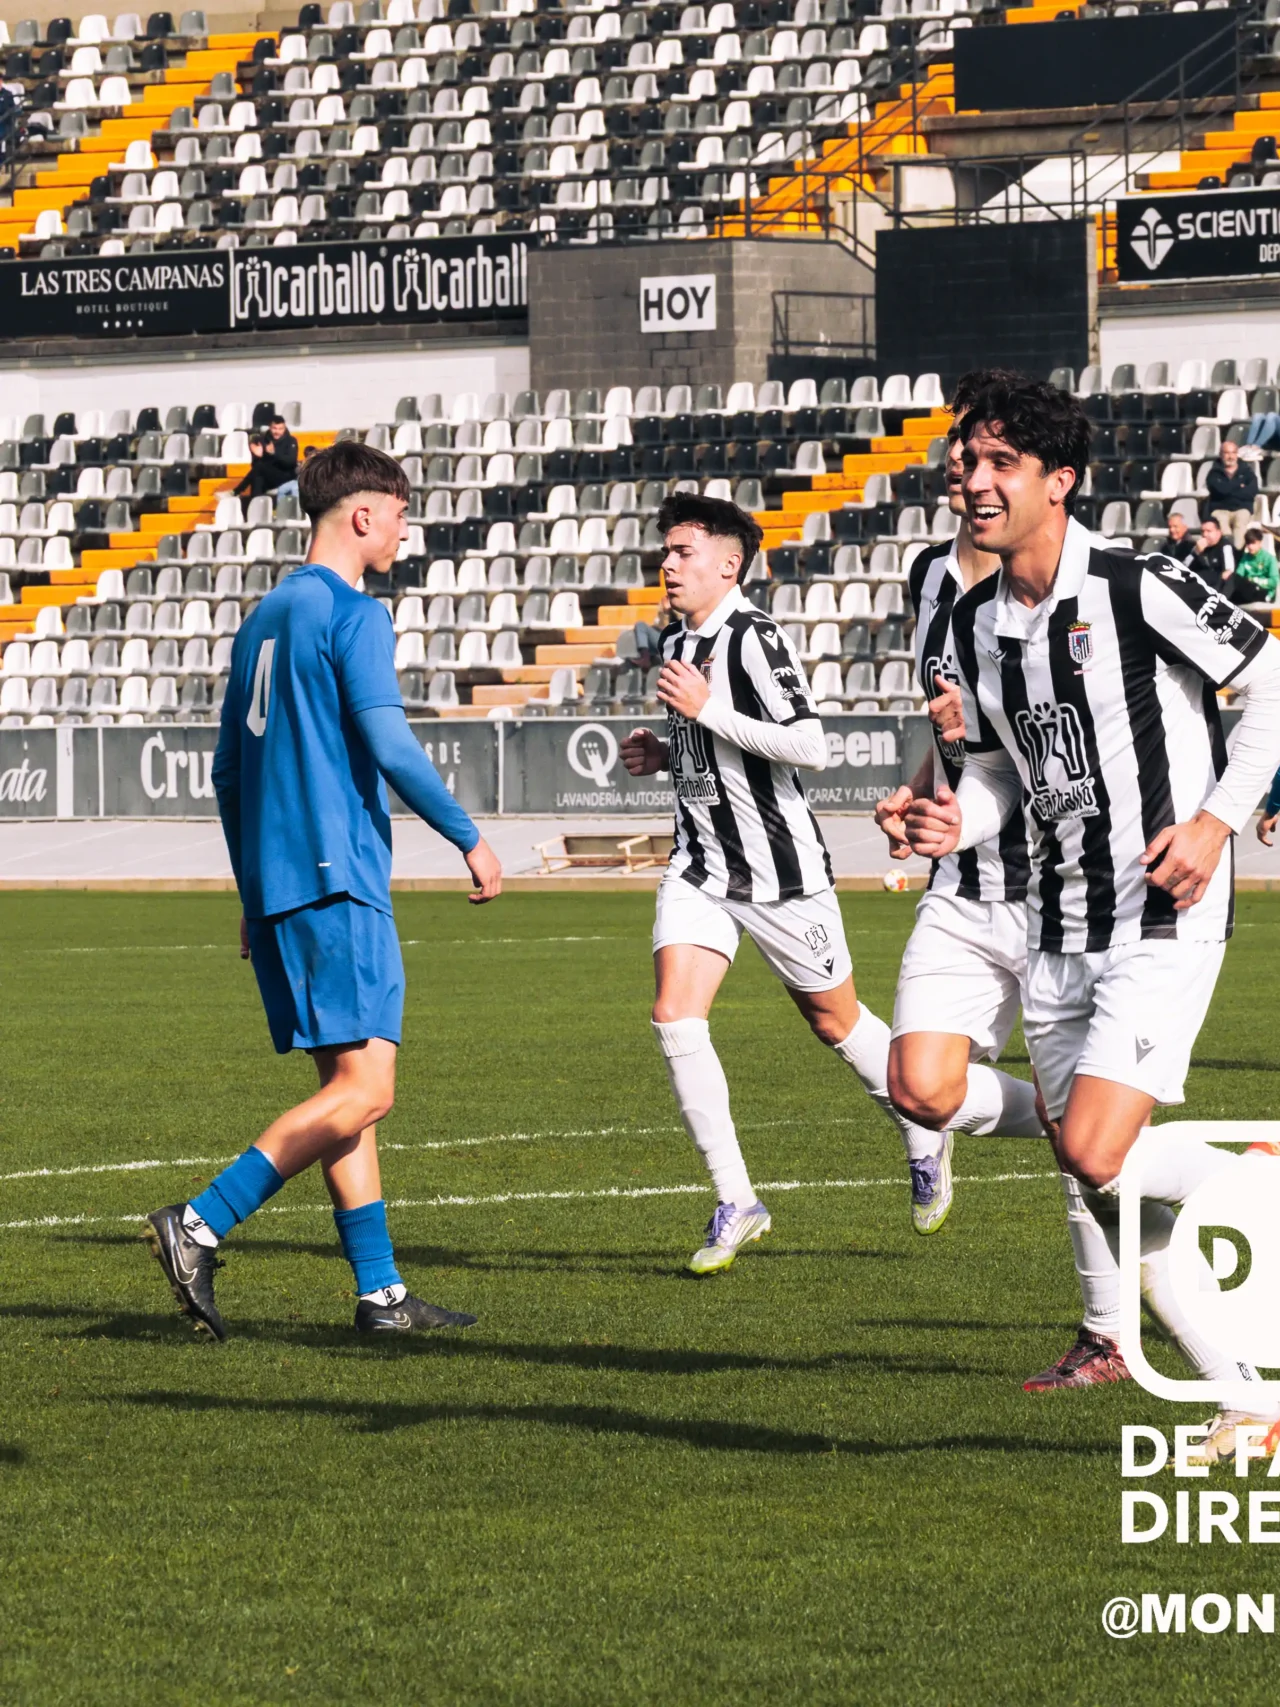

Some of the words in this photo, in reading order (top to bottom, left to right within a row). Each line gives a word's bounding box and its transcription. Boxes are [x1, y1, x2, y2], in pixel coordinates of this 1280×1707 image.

[21, 270, 60, 296] LAS
[62, 268, 112, 294] TRES
[115, 263, 224, 292] CAMPANAS
[273, 251, 385, 318] carballo
[76, 304, 110, 314] HOTEL
[115, 301, 169, 313] BOUTIQUE
[644, 285, 711, 321] HOY
[556, 789, 622, 807] LAVANDERÍA
[623, 791, 676, 806] AUTOSER
[844, 787, 853, 800] Y
